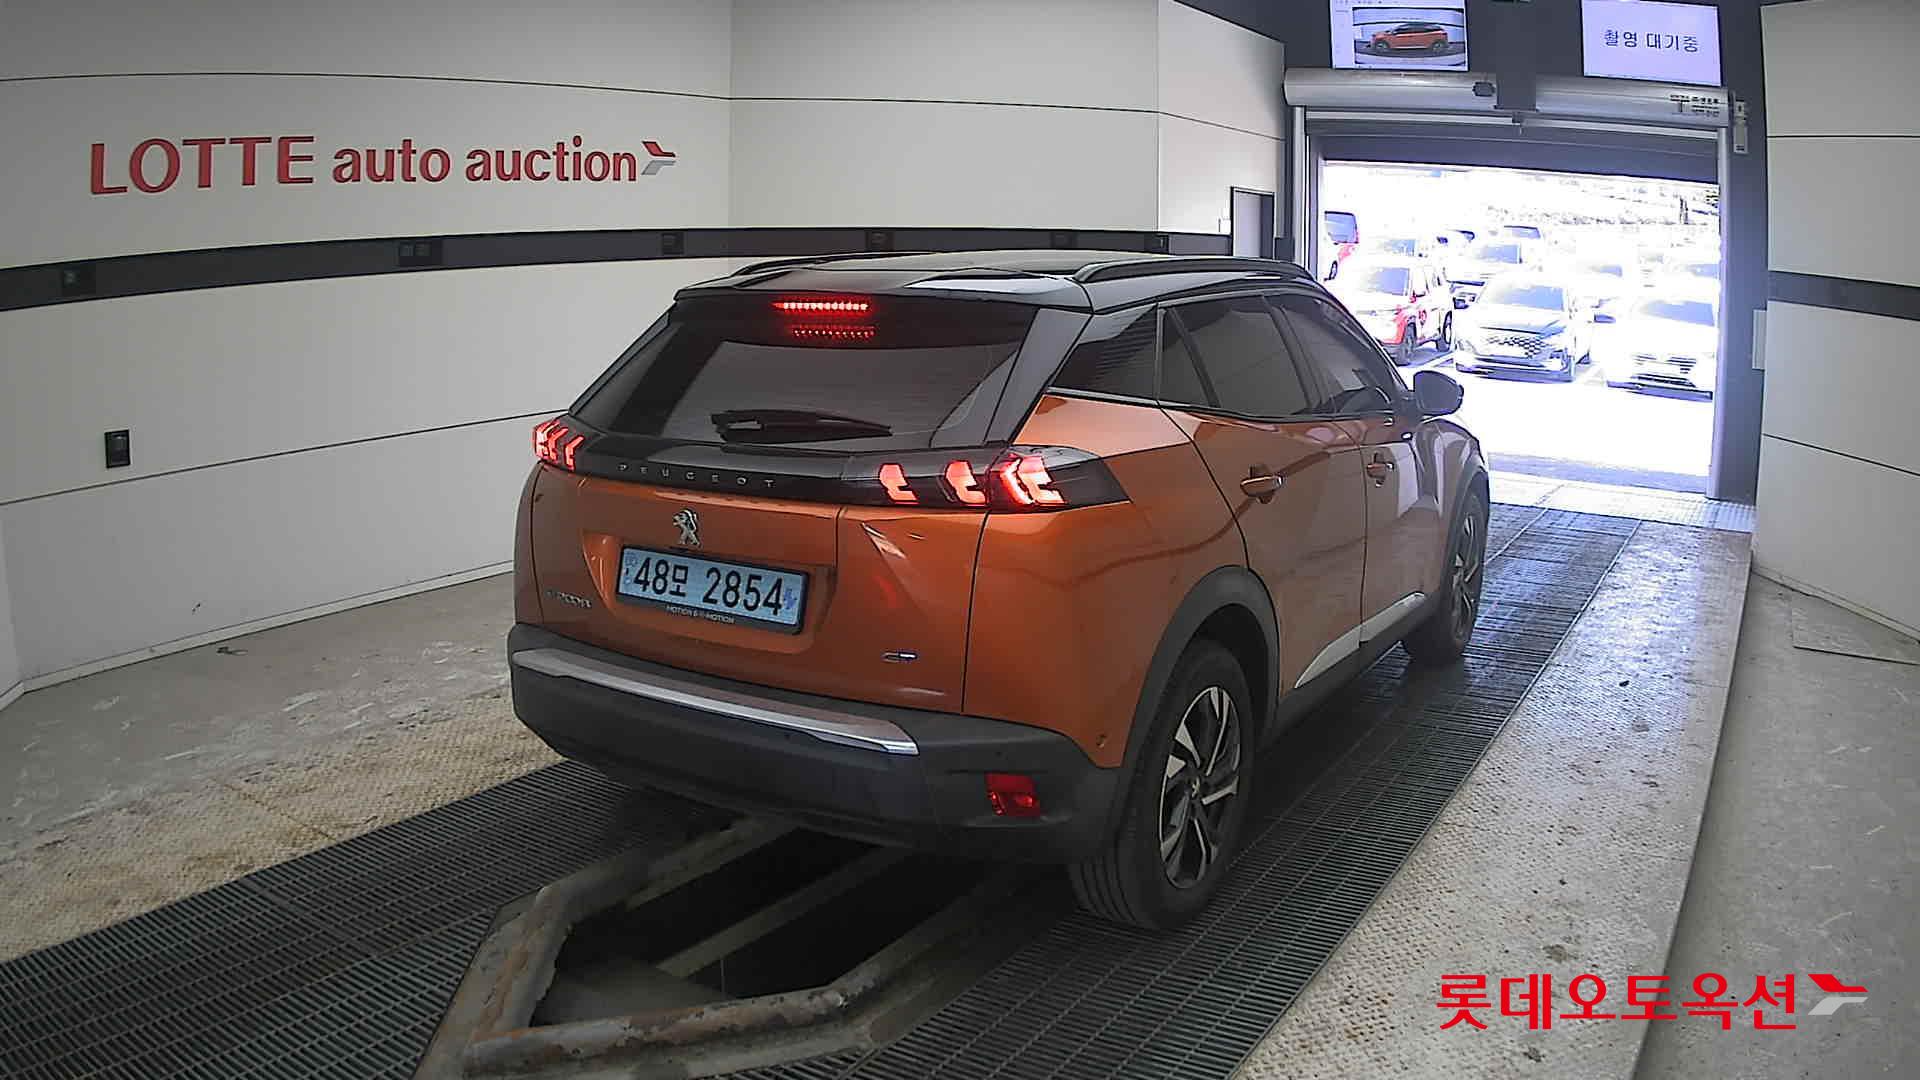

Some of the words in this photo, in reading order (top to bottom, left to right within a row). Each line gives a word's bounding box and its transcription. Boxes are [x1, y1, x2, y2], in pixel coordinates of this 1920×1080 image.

[1646, 32, 1698, 53] 대기중
[90, 135, 314, 195] LOTTE
[332, 138, 451, 183] auto
[465, 135, 637, 182] auction
[618, 464, 774, 487] PEUGEOT
[633, 557, 689, 597] 48모
[702, 567, 784, 616] 2854
